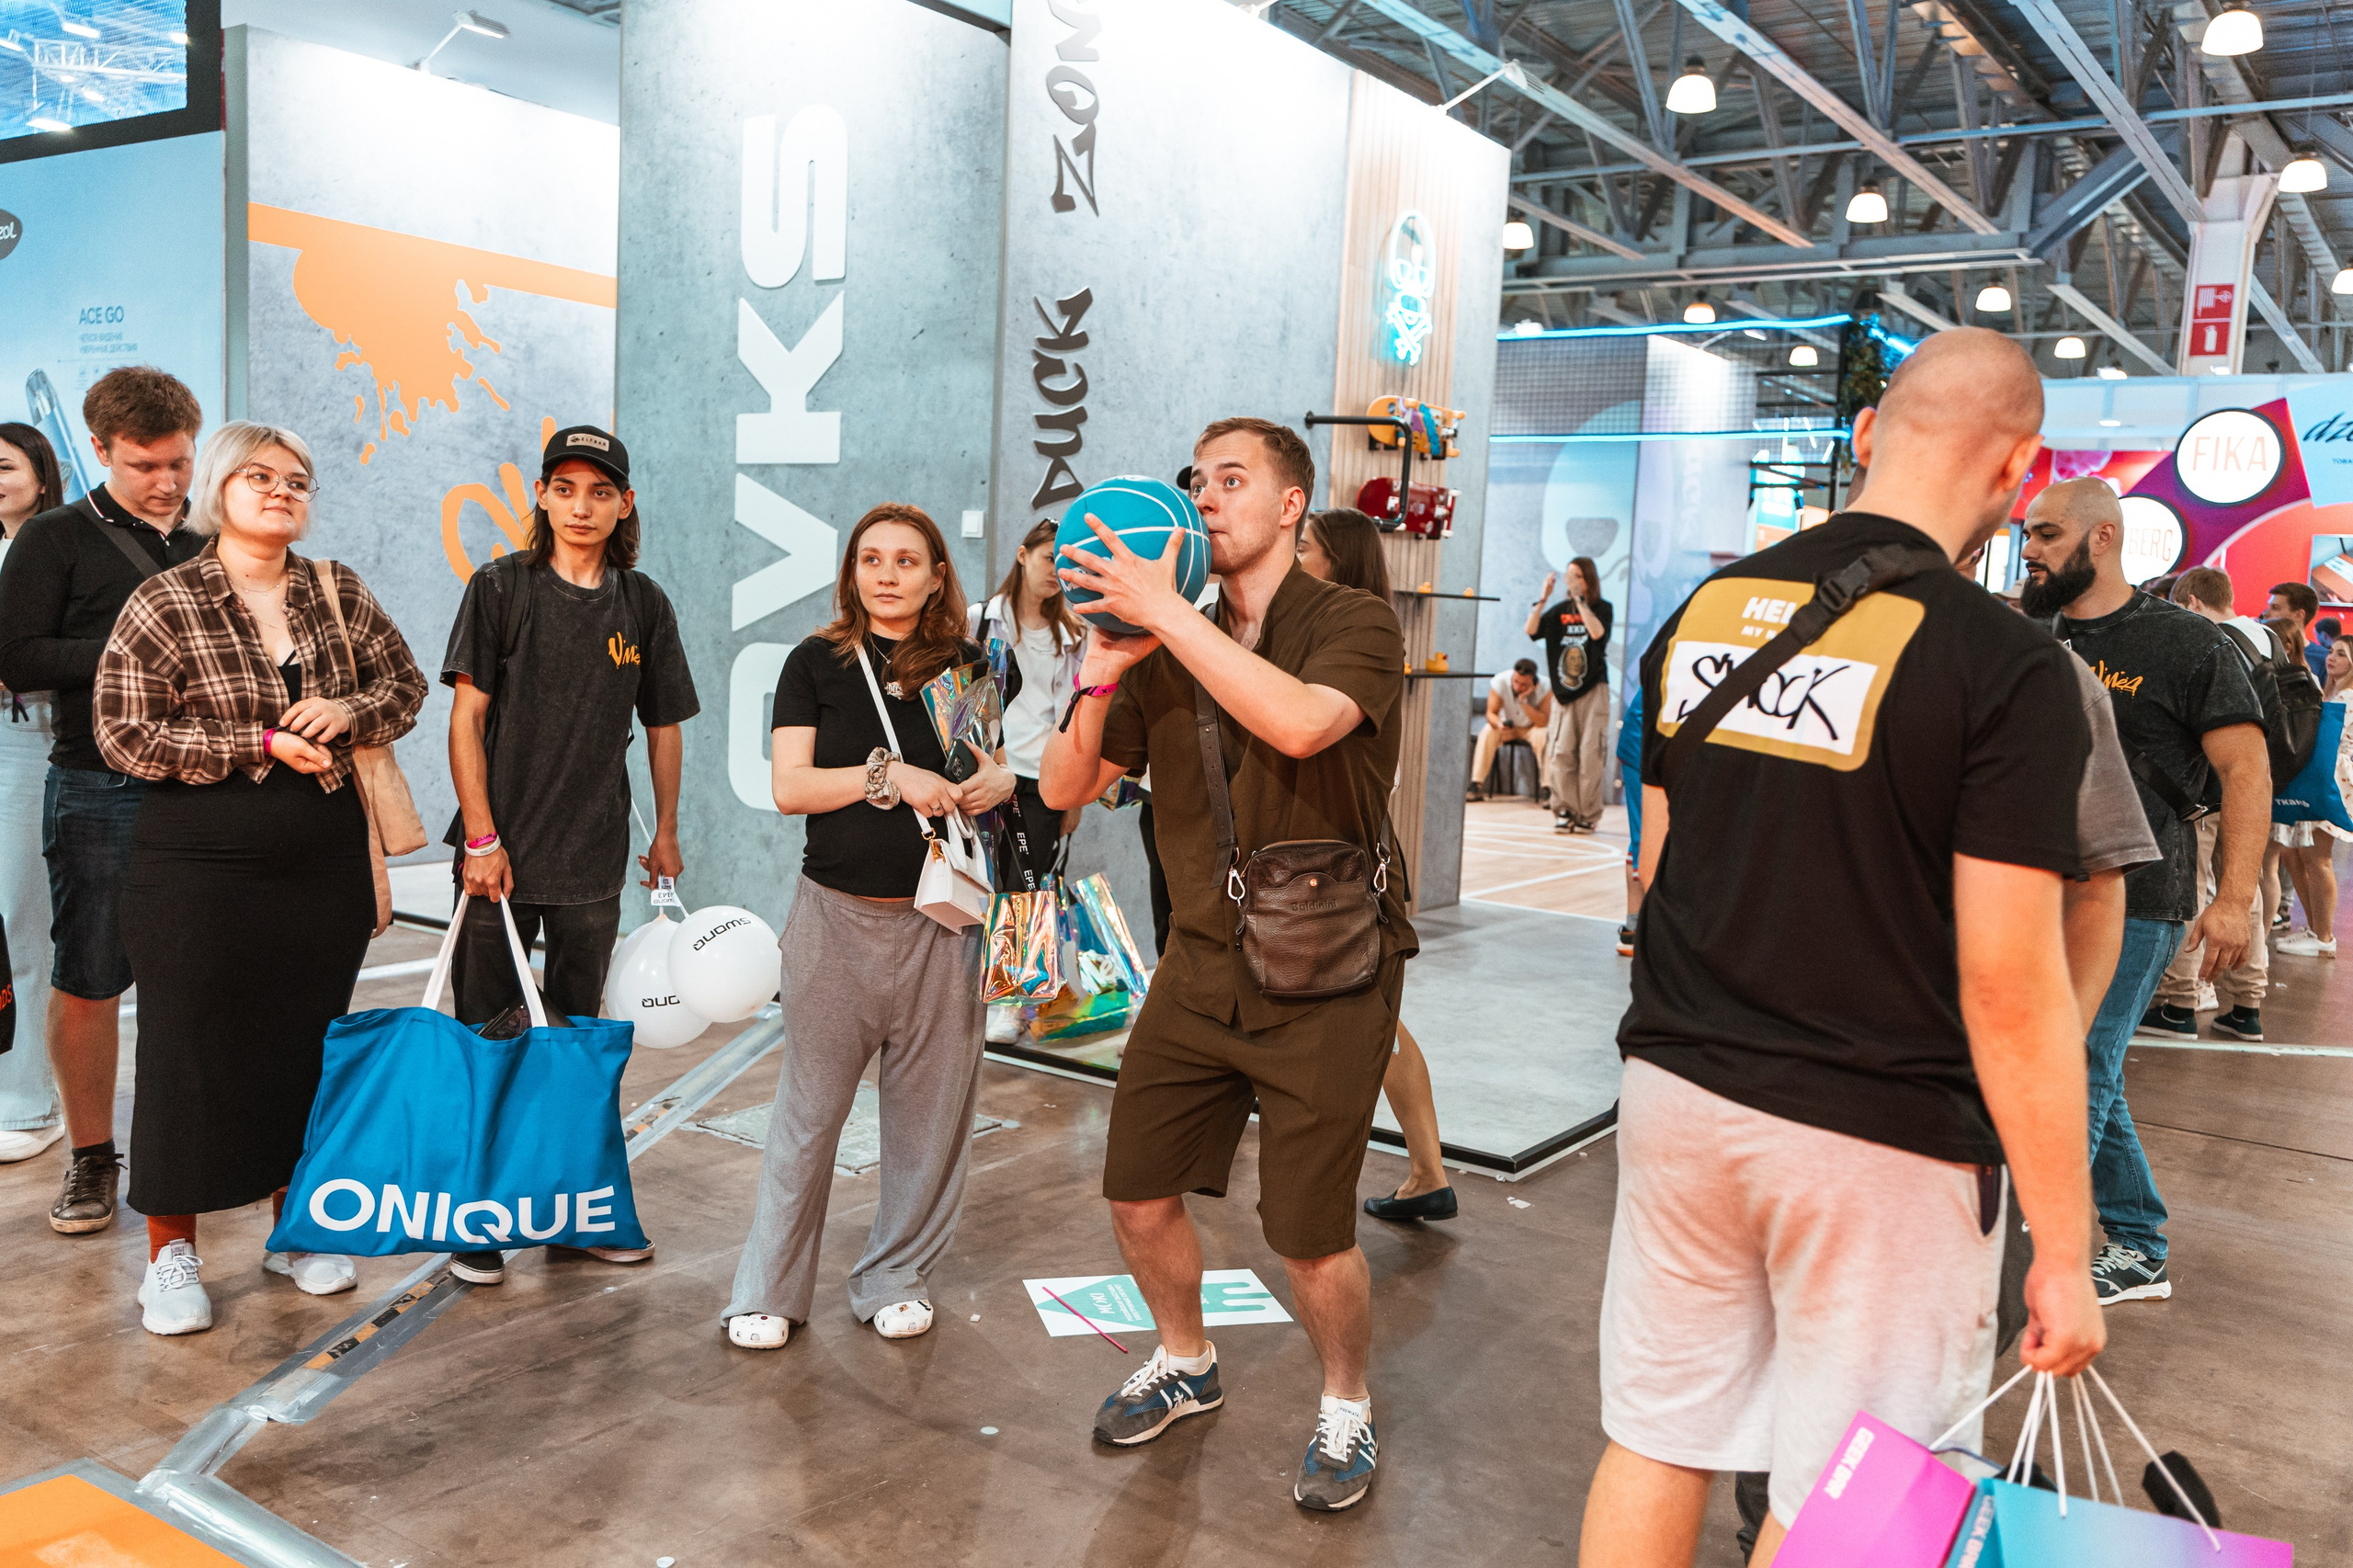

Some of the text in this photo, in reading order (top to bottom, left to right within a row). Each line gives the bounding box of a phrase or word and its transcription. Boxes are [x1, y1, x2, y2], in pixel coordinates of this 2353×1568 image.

[79, 305, 125, 325] ACE GO
[1031, 287, 1094, 511] DUCK
[581, 437, 607, 447] ELFBAR
[2192, 436, 2268, 472] FIKA
[2128, 528, 2173, 562] BERG
[1291, 899, 1337, 912] Baldinini
[309, 1178, 616, 1244] ONIQUE
[1339, 1406, 1360, 1418] PREMIATA
